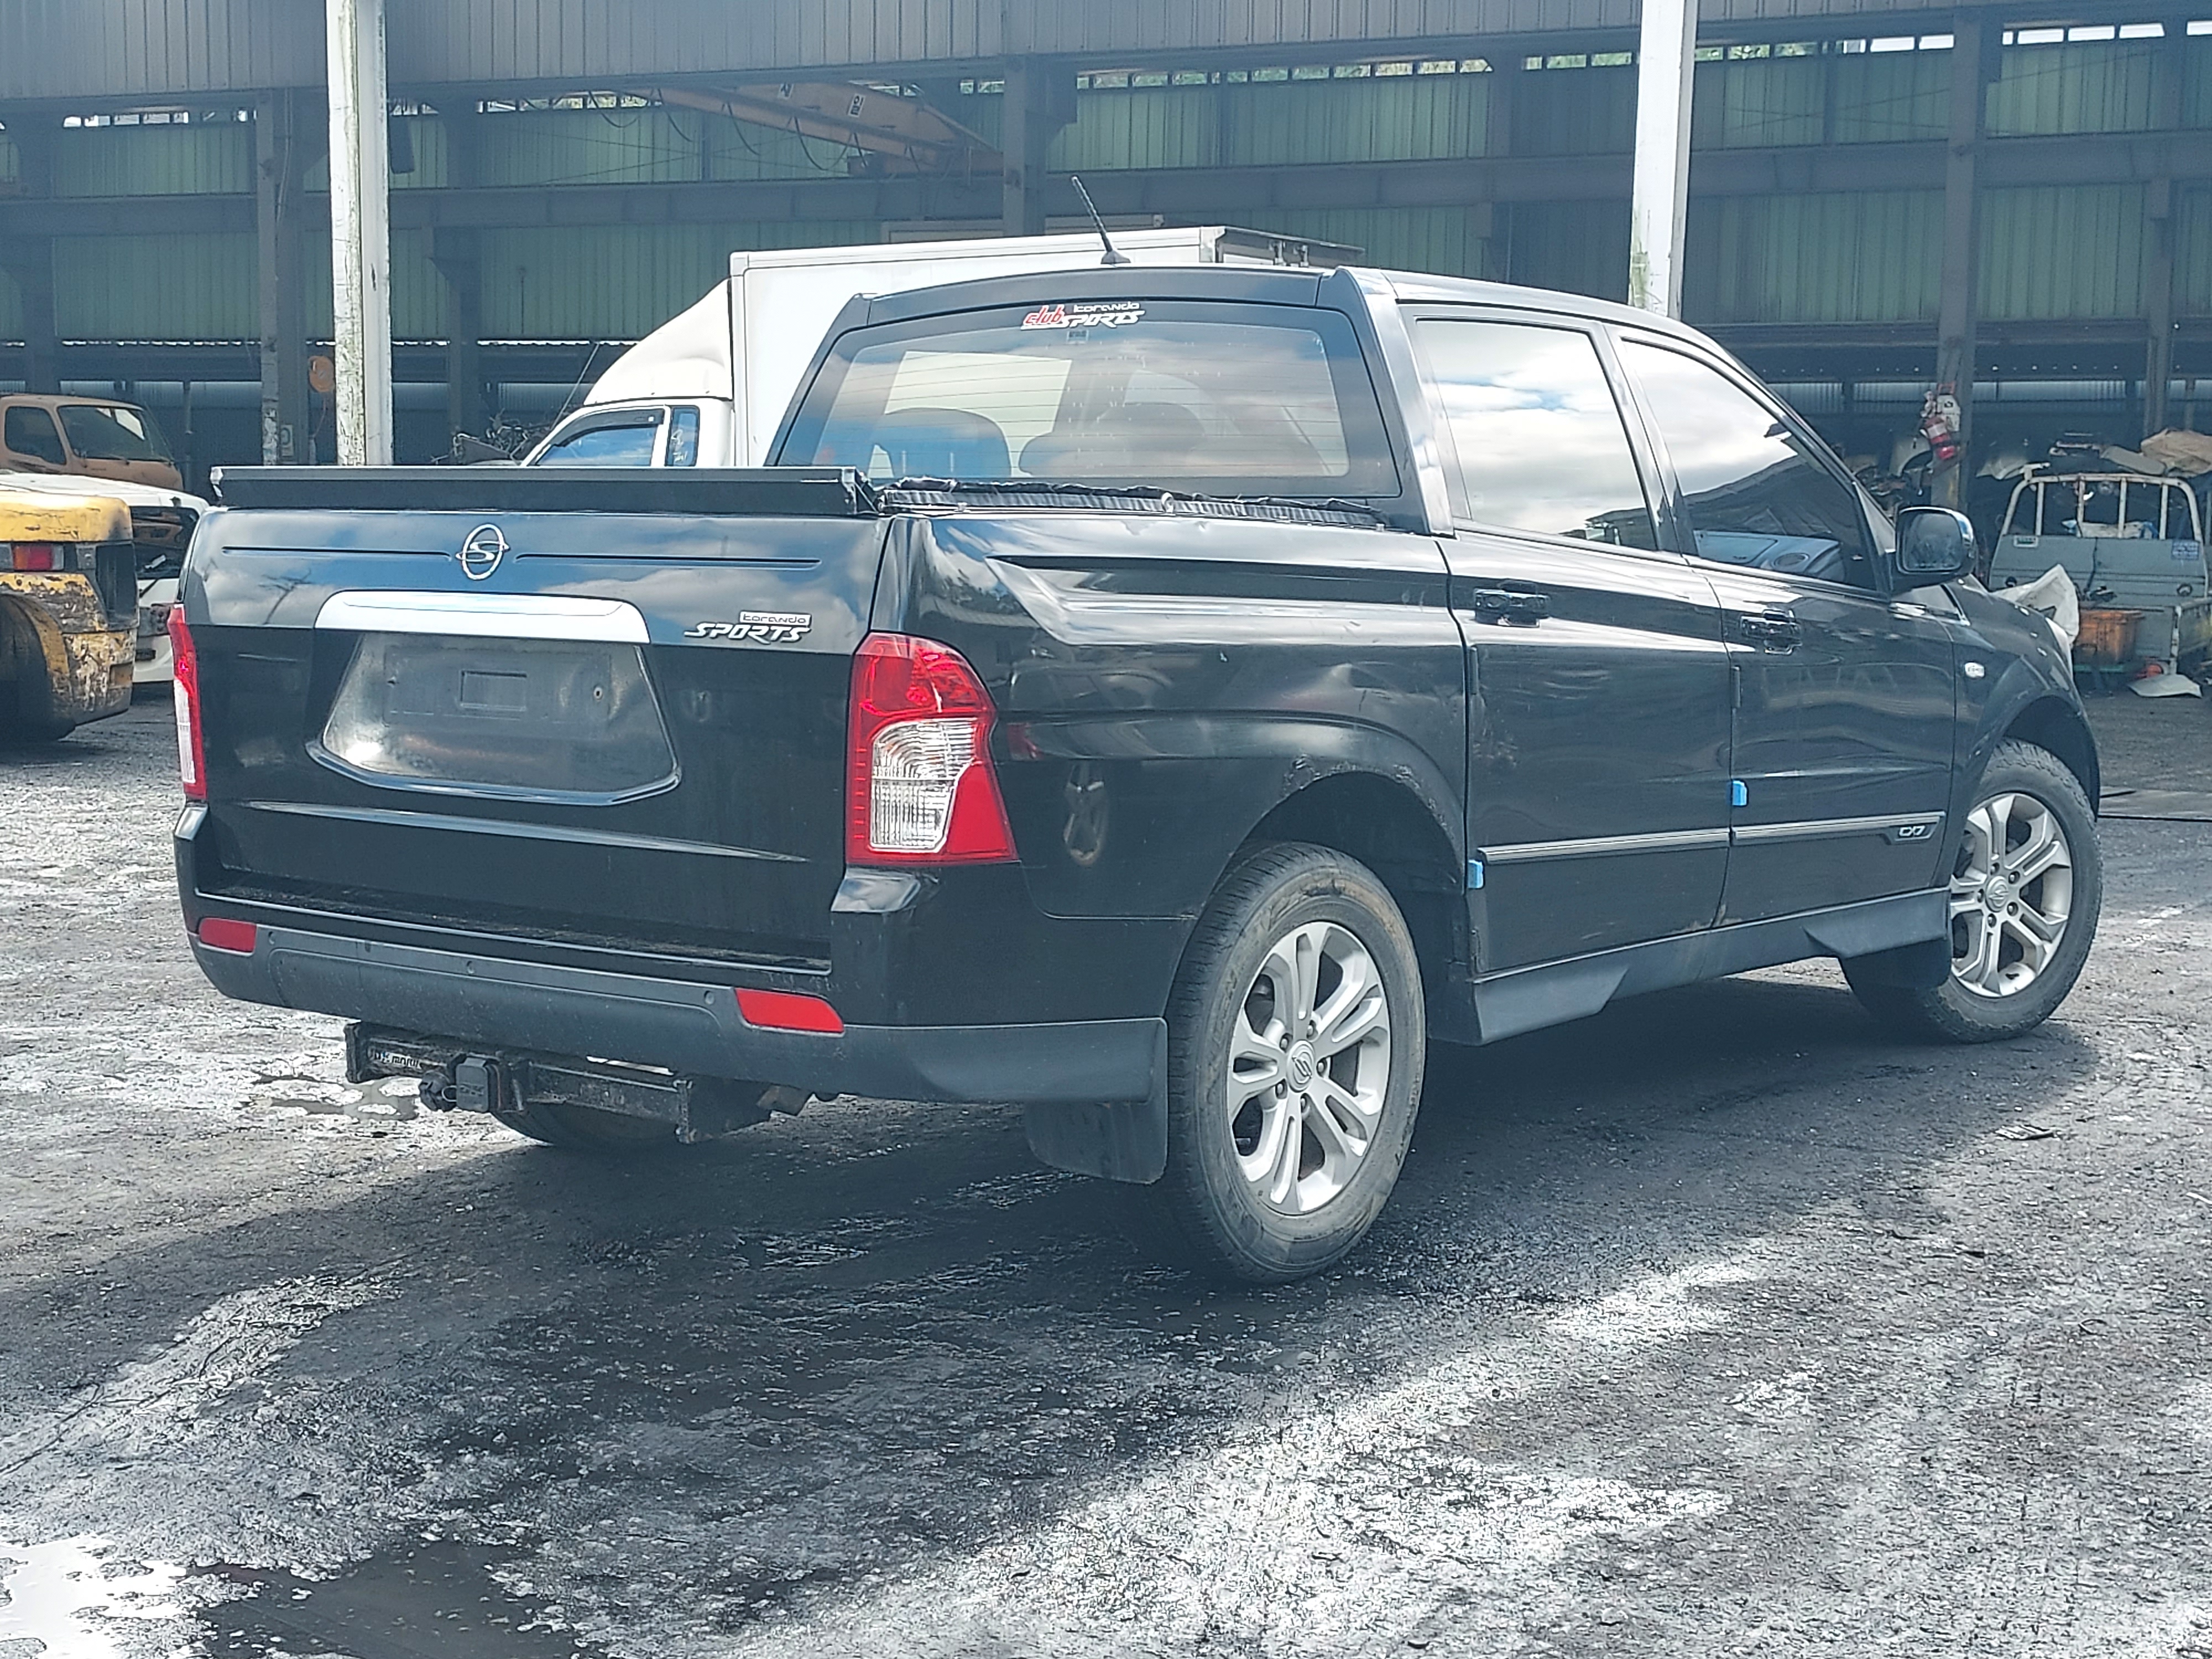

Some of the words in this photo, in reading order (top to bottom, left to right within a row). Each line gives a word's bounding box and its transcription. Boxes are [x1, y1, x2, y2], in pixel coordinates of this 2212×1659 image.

[1021, 310, 1145, 330] SPORTS
[1023, 304, 1065, 325] club
[684, 622, 811, 645] SPORTS
